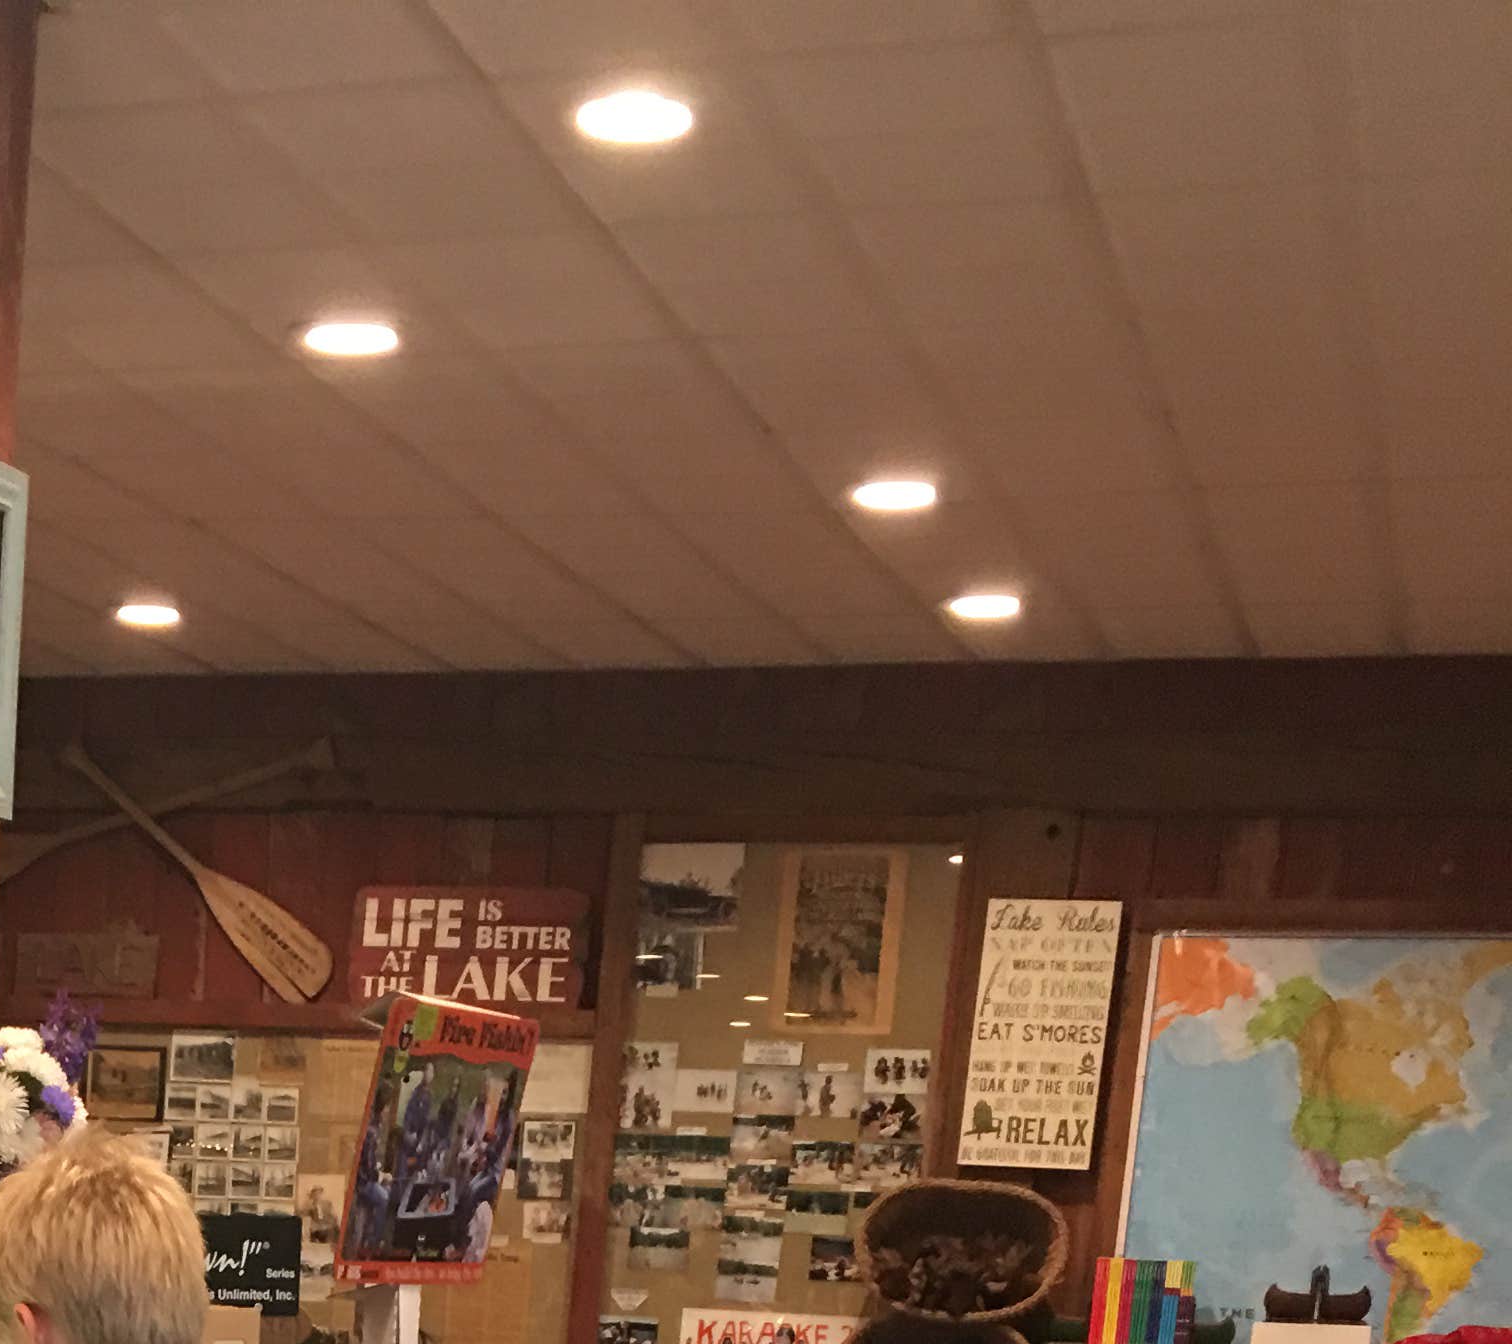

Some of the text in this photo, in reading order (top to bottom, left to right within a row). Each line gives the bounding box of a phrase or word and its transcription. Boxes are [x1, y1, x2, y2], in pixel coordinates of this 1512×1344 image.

[362, 896, 465, 949] LIFE
[478, 898, 504, 922] IS
[990, 903, 1116, 933] Lake Rules
[475, 925, 571, 951] BETTER
[379, 950, 417, 973] AT
[1049, 959, 1068, 972] THE
[360, 955, 570, 1002] THE LAKE
[977, 1022, 1103, 1045] EAT S'MORES
[1011, 1078, 1030, 1094] UP
[1035, 1079, 1062, 1095] THE
[1067, 1080, 1095, 1096] SUN
[1005, 1116, 1089, 1147] RELAX
[265, 1267, 296, 1279] Series
[217, 1288, 273, 1302] Unlimited,
[275, 1288, 296, 1301] Inc.
